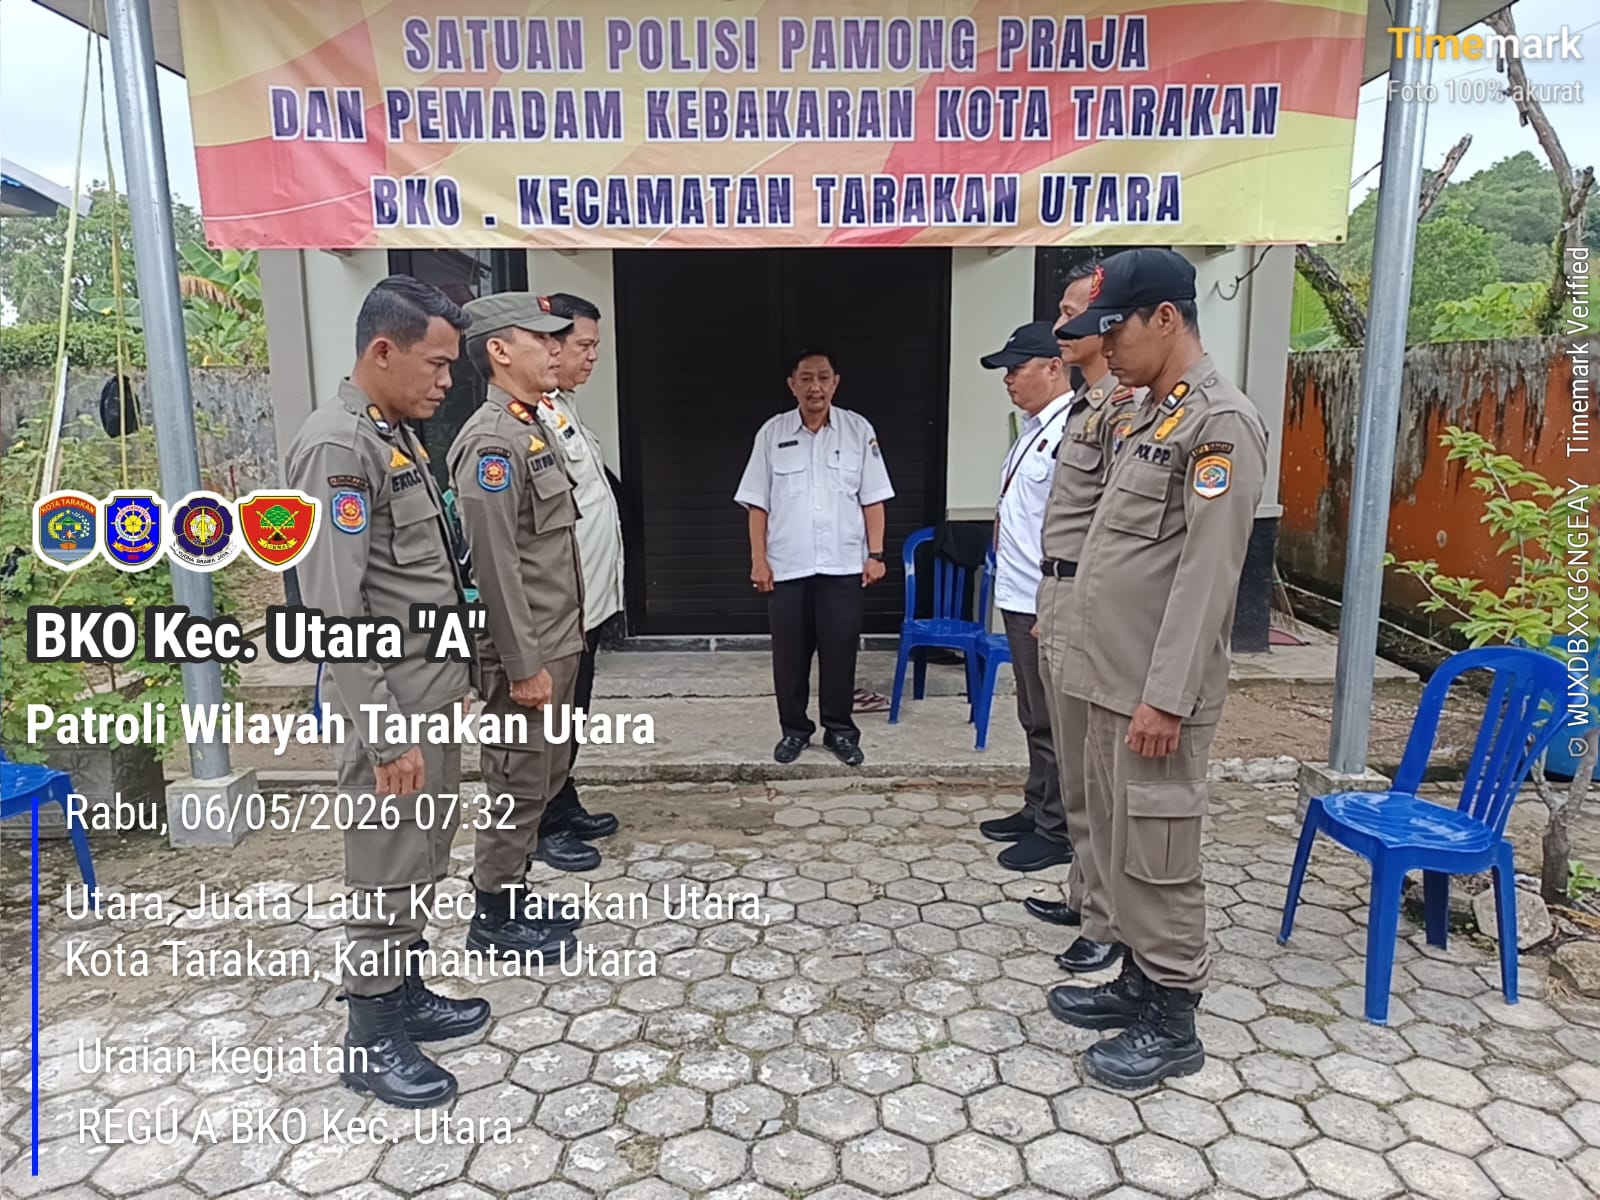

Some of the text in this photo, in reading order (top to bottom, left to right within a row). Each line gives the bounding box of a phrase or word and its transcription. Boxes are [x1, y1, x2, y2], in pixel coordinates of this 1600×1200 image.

[405, 15, 1149, 72] SATUAN POLISI PAMONG PRAJA
[269, 83, 1281, 142] DAN PEMADAM KEBAKARAN KOTA TARAKAN
[370, 175, 462, 229] BKO
[517, 173, 794, 229] KECAMATAN
[815, 173, 1019, 227] TARAKAN
[1039, 172, 1182, 226] UTARA
[1152, 447, 1171, 465] PP
